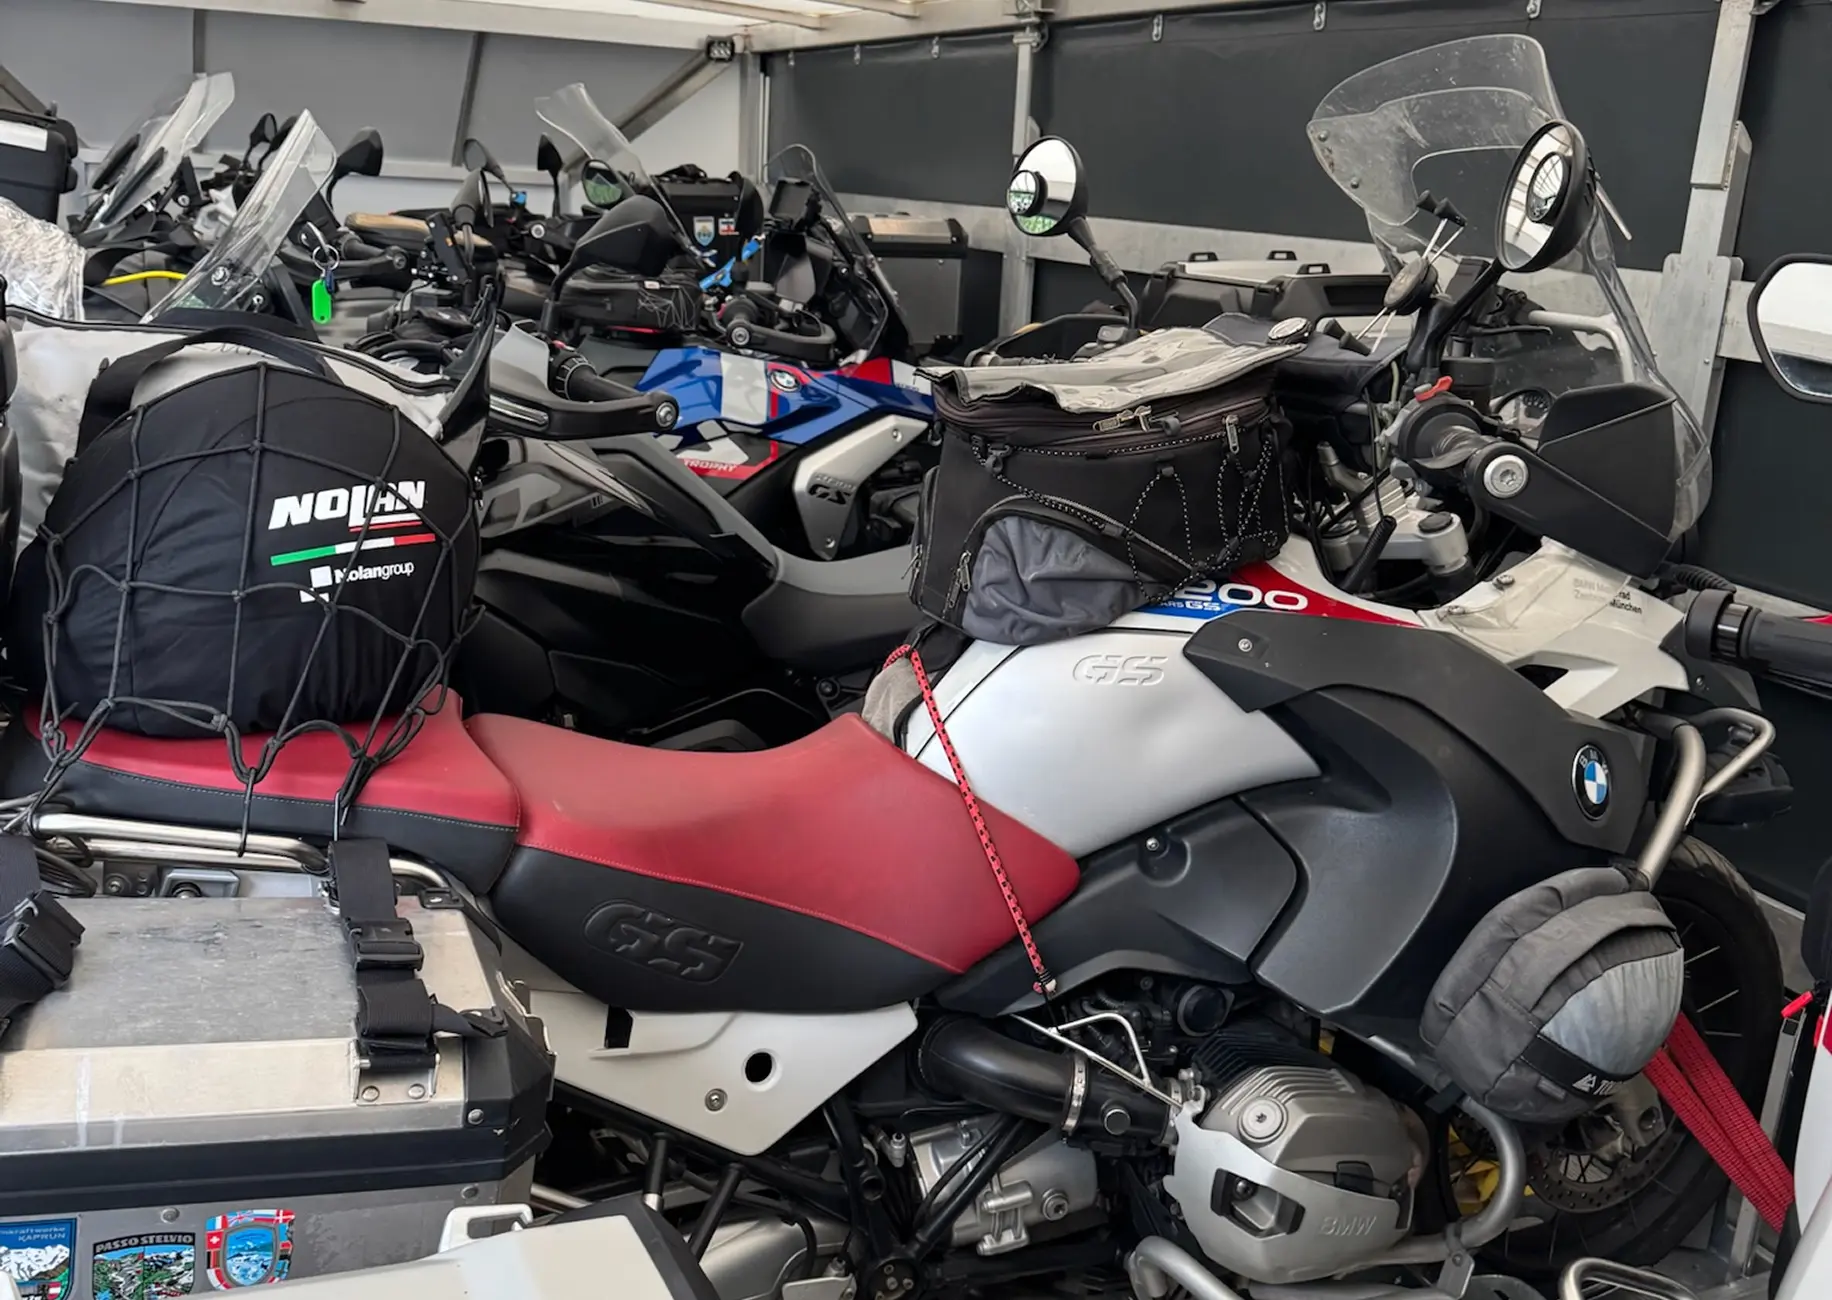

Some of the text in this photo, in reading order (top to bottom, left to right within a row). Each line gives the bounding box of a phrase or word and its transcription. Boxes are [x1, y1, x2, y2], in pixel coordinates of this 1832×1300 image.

[268, 480, 426, 528] NOLAN
[95, 1234, 193, 1253] PASSO STELVIO
